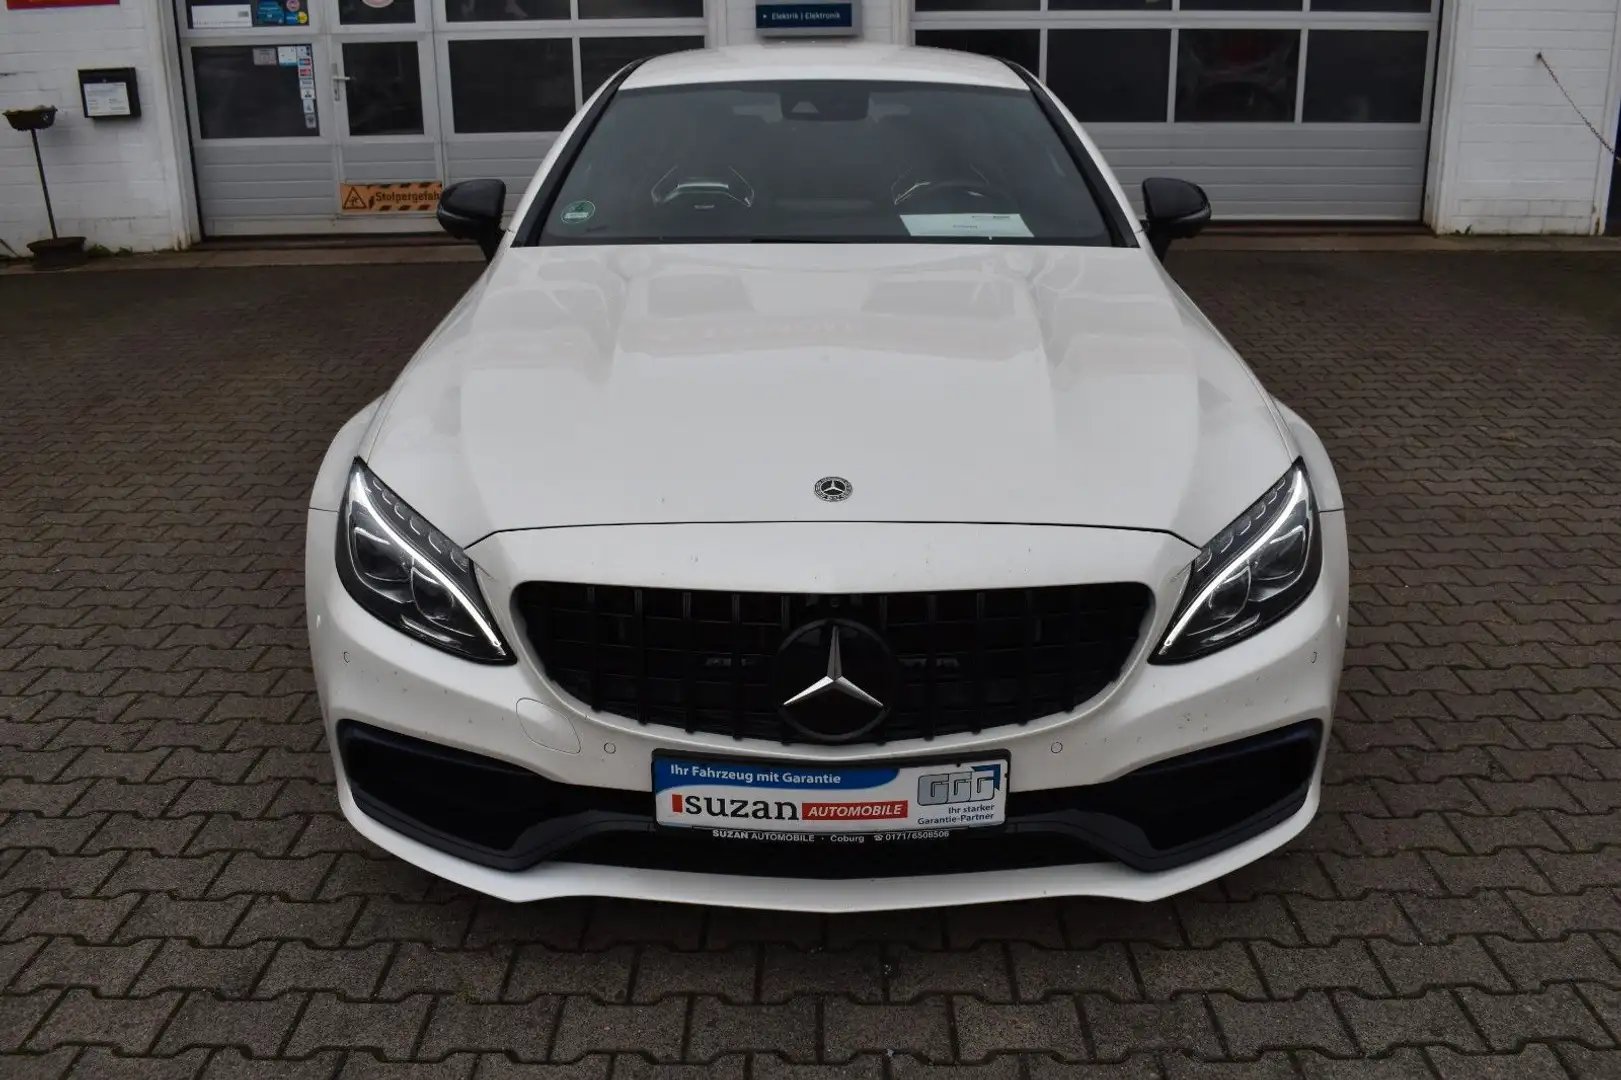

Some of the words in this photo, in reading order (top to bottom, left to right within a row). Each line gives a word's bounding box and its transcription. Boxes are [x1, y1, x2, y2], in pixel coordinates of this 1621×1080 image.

[771, 12, 799, 21] Elektrik
[805, 11, 841, 21] Elektronik
[375, 190, 441, 205] Stolpergefah
[670, 764, 689, 775] Ihr
[692, 766, 753, 783] Fahrzeug
[756, 770, 780, 783] mit
[782, 771, 841, 784] Garantie
[807, 804, 902, 818] AUTOMOBILE
[948, 805, 961, 814] Ihr
[962, 803, 995, 814] starker
[917, 813, 994, 825] Garantie-Partner
[712, 828, 749, 840] SUZAN
[750, 831, 814, 843] AUTOMOBILE
[829, 833, 864, 844] Coburg
